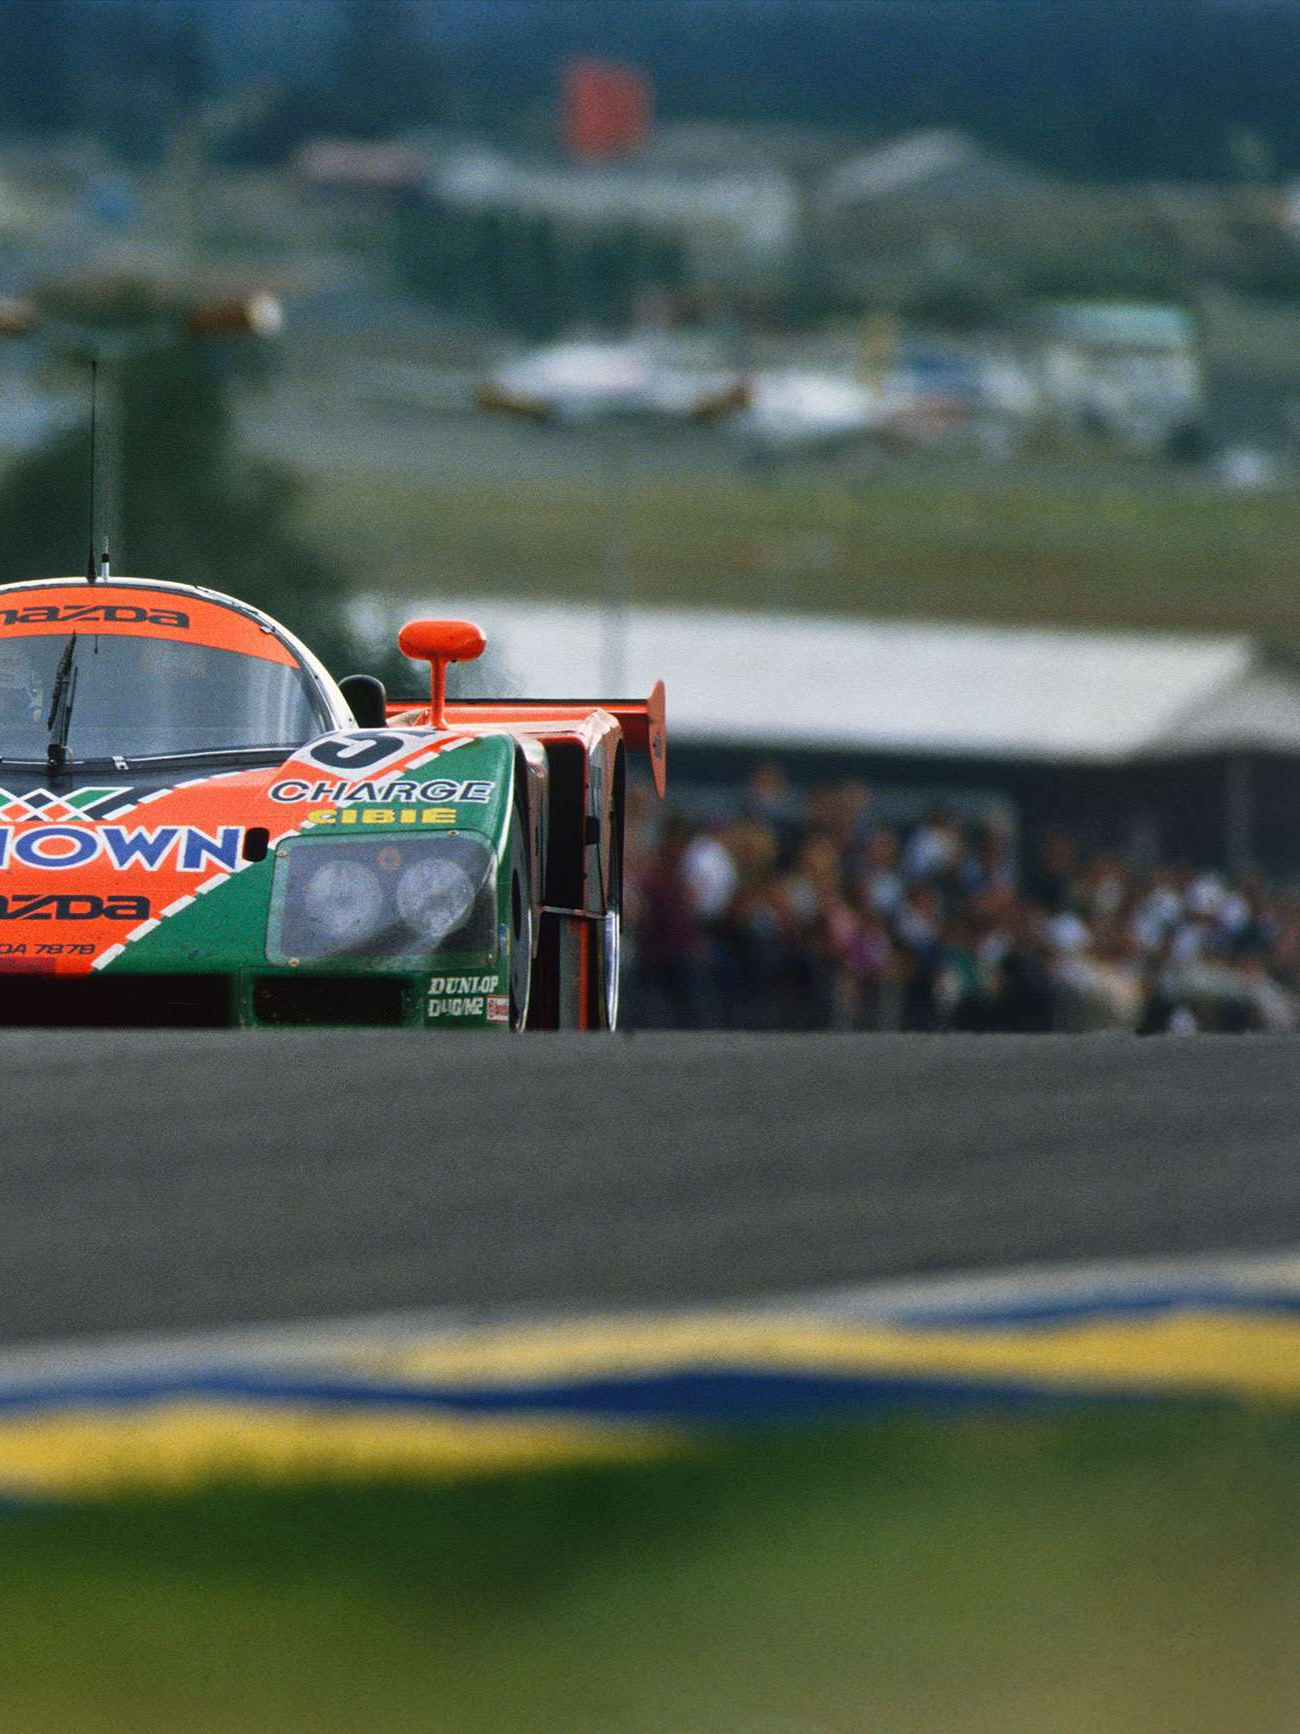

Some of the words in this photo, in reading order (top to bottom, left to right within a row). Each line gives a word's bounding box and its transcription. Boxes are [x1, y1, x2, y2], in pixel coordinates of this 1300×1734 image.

[268, 779, 497, 804] CHARGE
[307, 808, 457, 824] CIBIE
[35, 943, 96, 955] 787B
[427, 975, 499, 995] DUNLOP
